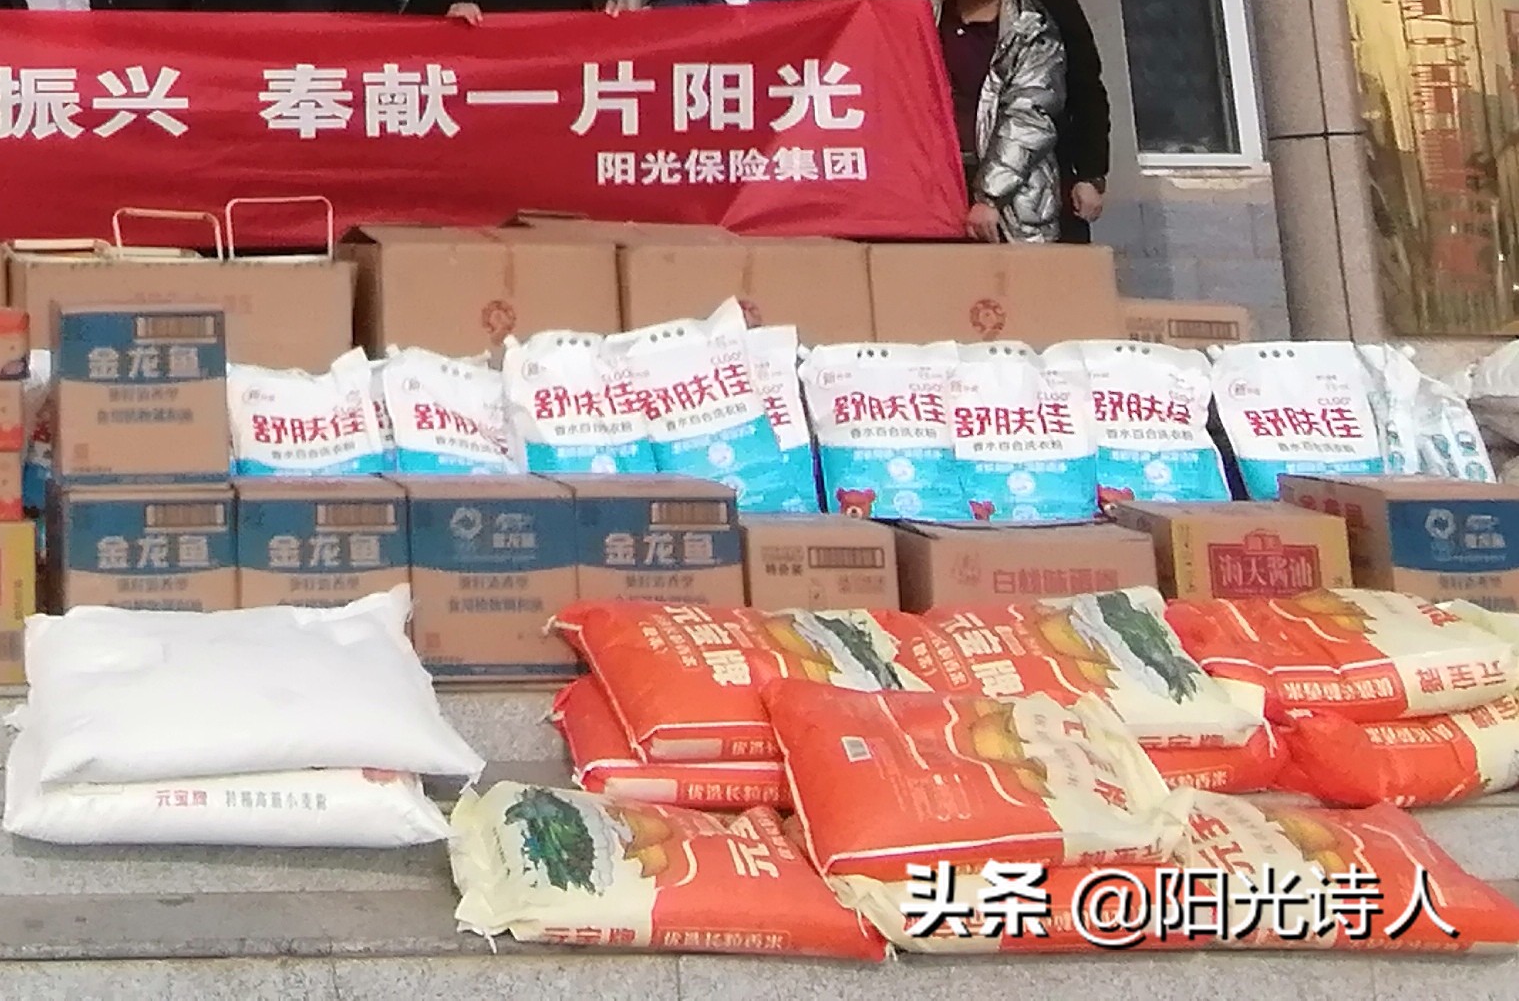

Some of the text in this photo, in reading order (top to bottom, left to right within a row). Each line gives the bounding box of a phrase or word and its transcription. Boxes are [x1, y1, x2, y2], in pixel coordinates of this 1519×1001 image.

[259, 59, 866, 138] 奉献一片阳光
[596, 148, 868, 185] 阳光保险集团
[88, 346, 202, 379] 金龙鱼
[640, 363, 753, 420] 舒肤佳
[834, 392, 946, 425] 舒肤佳
[954, 403, 1075, 438] 舒肤佳
[1243, 407, 1363, 439] 舒肤佳
[252, 411, 366, 444] 舒肤佳
[96, 535, 212, 569] 金龙鱼
[267, 535, 381, 568] 金龙鱼
[604, 532, 716, 566] 金龙鱼
[156, 789, 208, 807] 元宝牌
